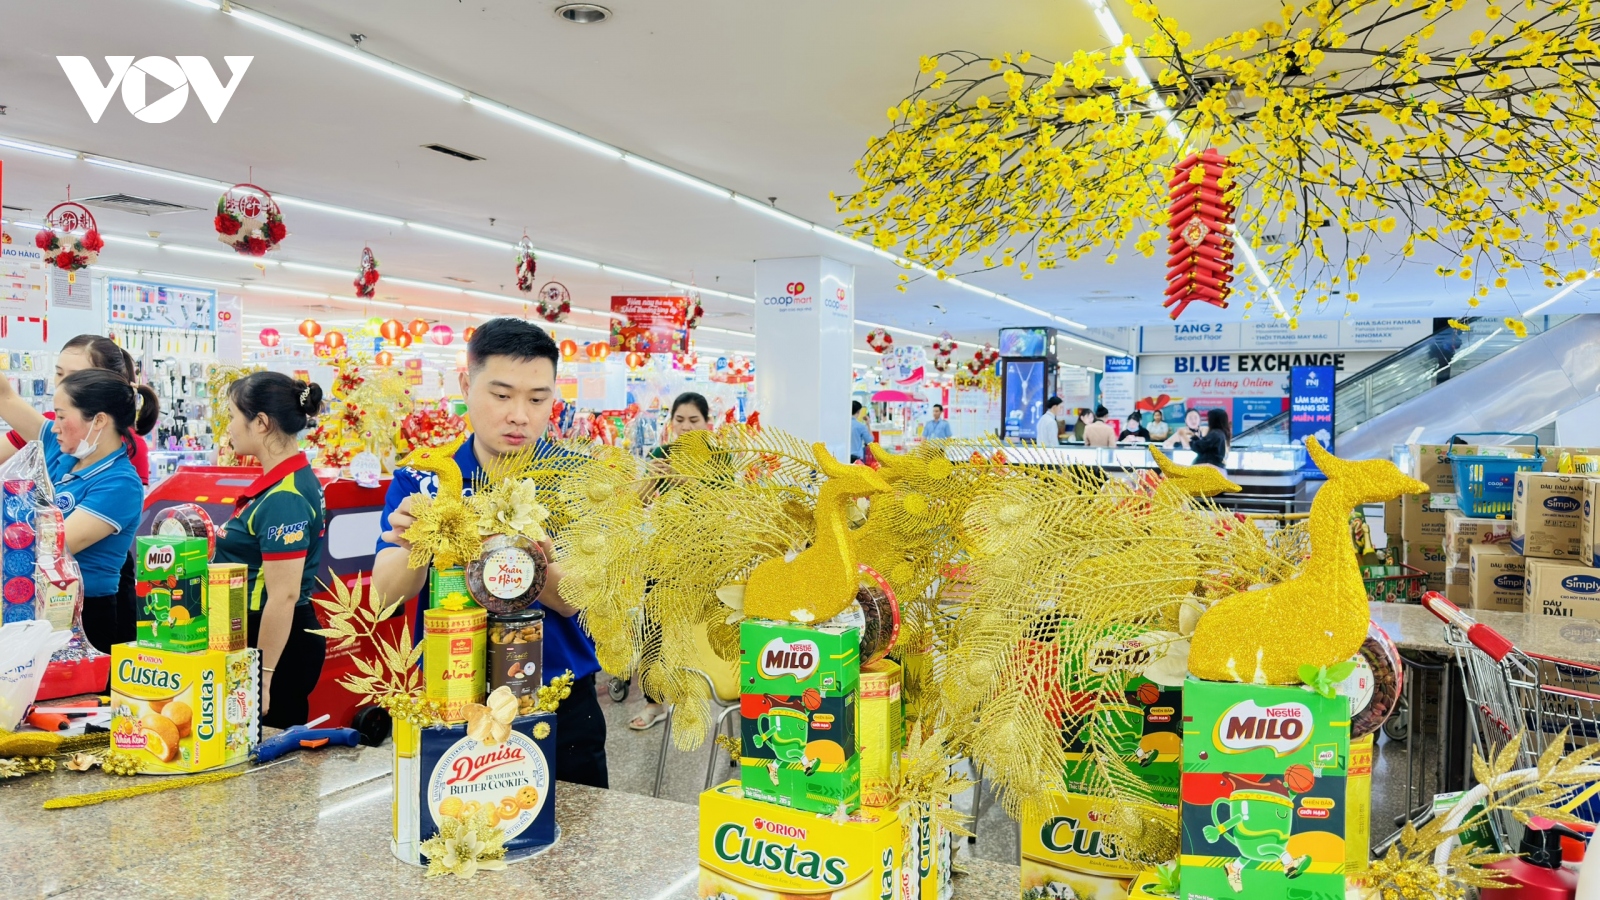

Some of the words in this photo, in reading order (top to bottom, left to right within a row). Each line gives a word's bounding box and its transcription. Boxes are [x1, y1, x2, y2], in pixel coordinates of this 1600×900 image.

[1215, 323, 1223, 333] 2
[1174, 355, 1231, 373] BLUE
[1238, 353, 1346, 372] EXCHANGE
[1242, 376, 1274, 388] Online
[1293, 404, 1316, 412] TRANG
[1547, 498, 1578, 510] Simply
[267, 520, 309, 541] Power
[283, 531, 304, 545] 100
[148, 553, 172, 565] MILO
[143, 657, 163, 665] ORION
[765, 650, 814, 669] MILO
[118, 659, 181, 690] Custas
[197, 670, 215, 741] Custas
[1266, 707, 1301, 718] Nestlé
[1226, 716, 1303, 740] MILO
[446, 744, 526, 785] Danisa
[485, 770, 526, 781] TRADITIONAL
[449, 782, 488, 796] BUTTER
[488, 777, 530, 791] COOKIES
[766, 821, 806, 840] ORION
[714, 823, 846, 886] Custas
